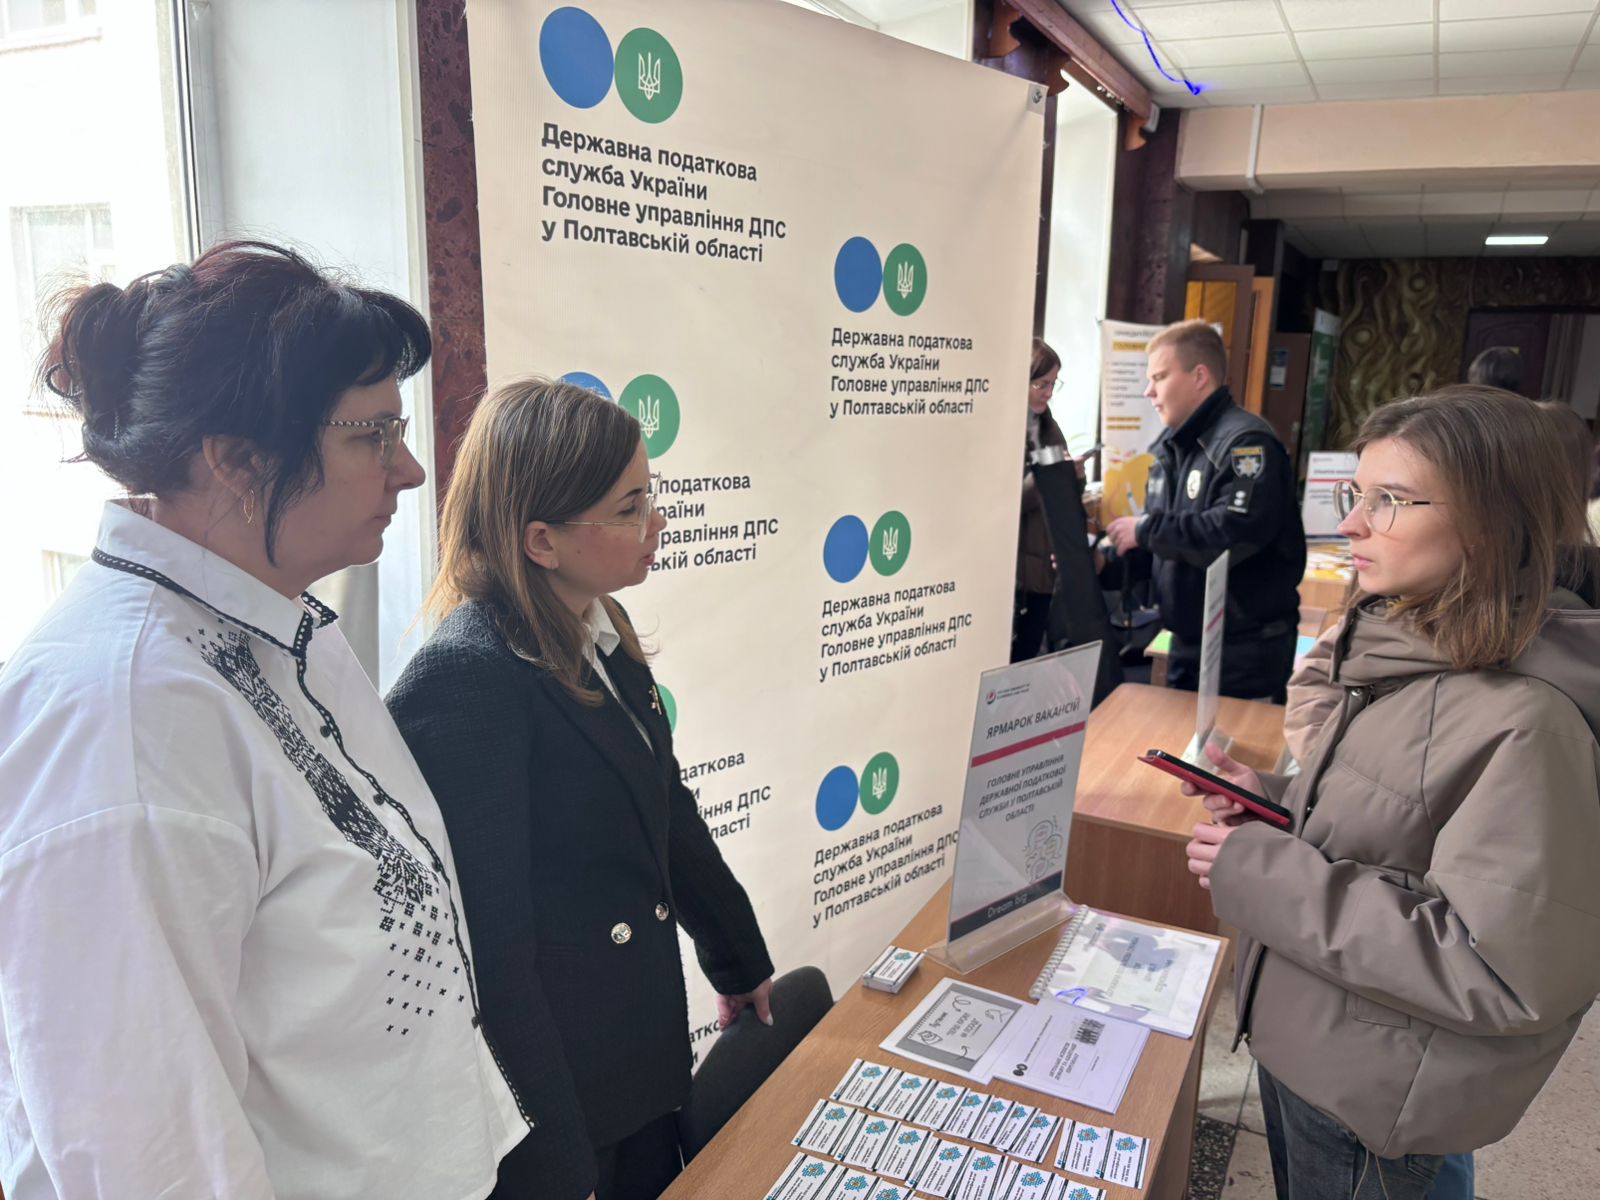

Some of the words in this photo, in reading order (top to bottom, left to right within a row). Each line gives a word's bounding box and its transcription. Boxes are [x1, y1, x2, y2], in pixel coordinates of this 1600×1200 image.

[541, 122, 652, 163] Державна
[658, 149, 757, 182] податкова
[542, 158, 625, 187] служба
[630, 169, 707, 200] України
[543, 185, 631, 217] Головне
[635, 203, 744, 233] управління
[749, 217, 786, 239] ДПС
[541, 220, 557, 242] у
[564, 219, 689, 254] Полтавській
[695, 238, 763, 262] області
[831, 327, 904, 348] Державна
[908, 335, 972, 351] податкова
[831, 353, 885, 372] служба
[889, 354, 940, 373] України
[831, 375, 888, 392] Головне
[891, 377, 962, 396] управління
[964, 378, 989, 395] ДПС
[829, 402, 839, 419] у
[843, 399, 926, 415] Полтавській
[929, 398, 973, 414] області
[659, 475, 752, 495] податкова
[743, 518, 778, 540] ДПС
[693, 543, 756, 567] області
[822, 592, 890, 618] Державна
[894, 581, 955, 602] податкова
[821, 614, 872, 637] служба
[876, 605, 924, 626] України
[821, 636, 875, 658] Головне
[878, 621, 945, 649] управління
[948, 613, 972, 632] ДПС
[819, 667, 828, 683] у
[832, 645, 911, 677] Полтавській
[914, 635, 956, 657] області
[987, 714, 1033, 739] ЯРМАРОК
[1035, 696, 1081, 723] ВАКАНСІЙ
[737, 785, 771, 812] ДПС
[814, 829, 880, 868] Державна
[883, 804, 942, 836] податкова
[813, 854, 862, 885] служба
[866, 835, 913, 862] України
[814, 874, 866, 905] Головне
[869, 844, 934, 884] управління
[813, 912, 821, 929] у
[825, 874, 901, 920] Полтавській
[904, 853, 944, 883] області
